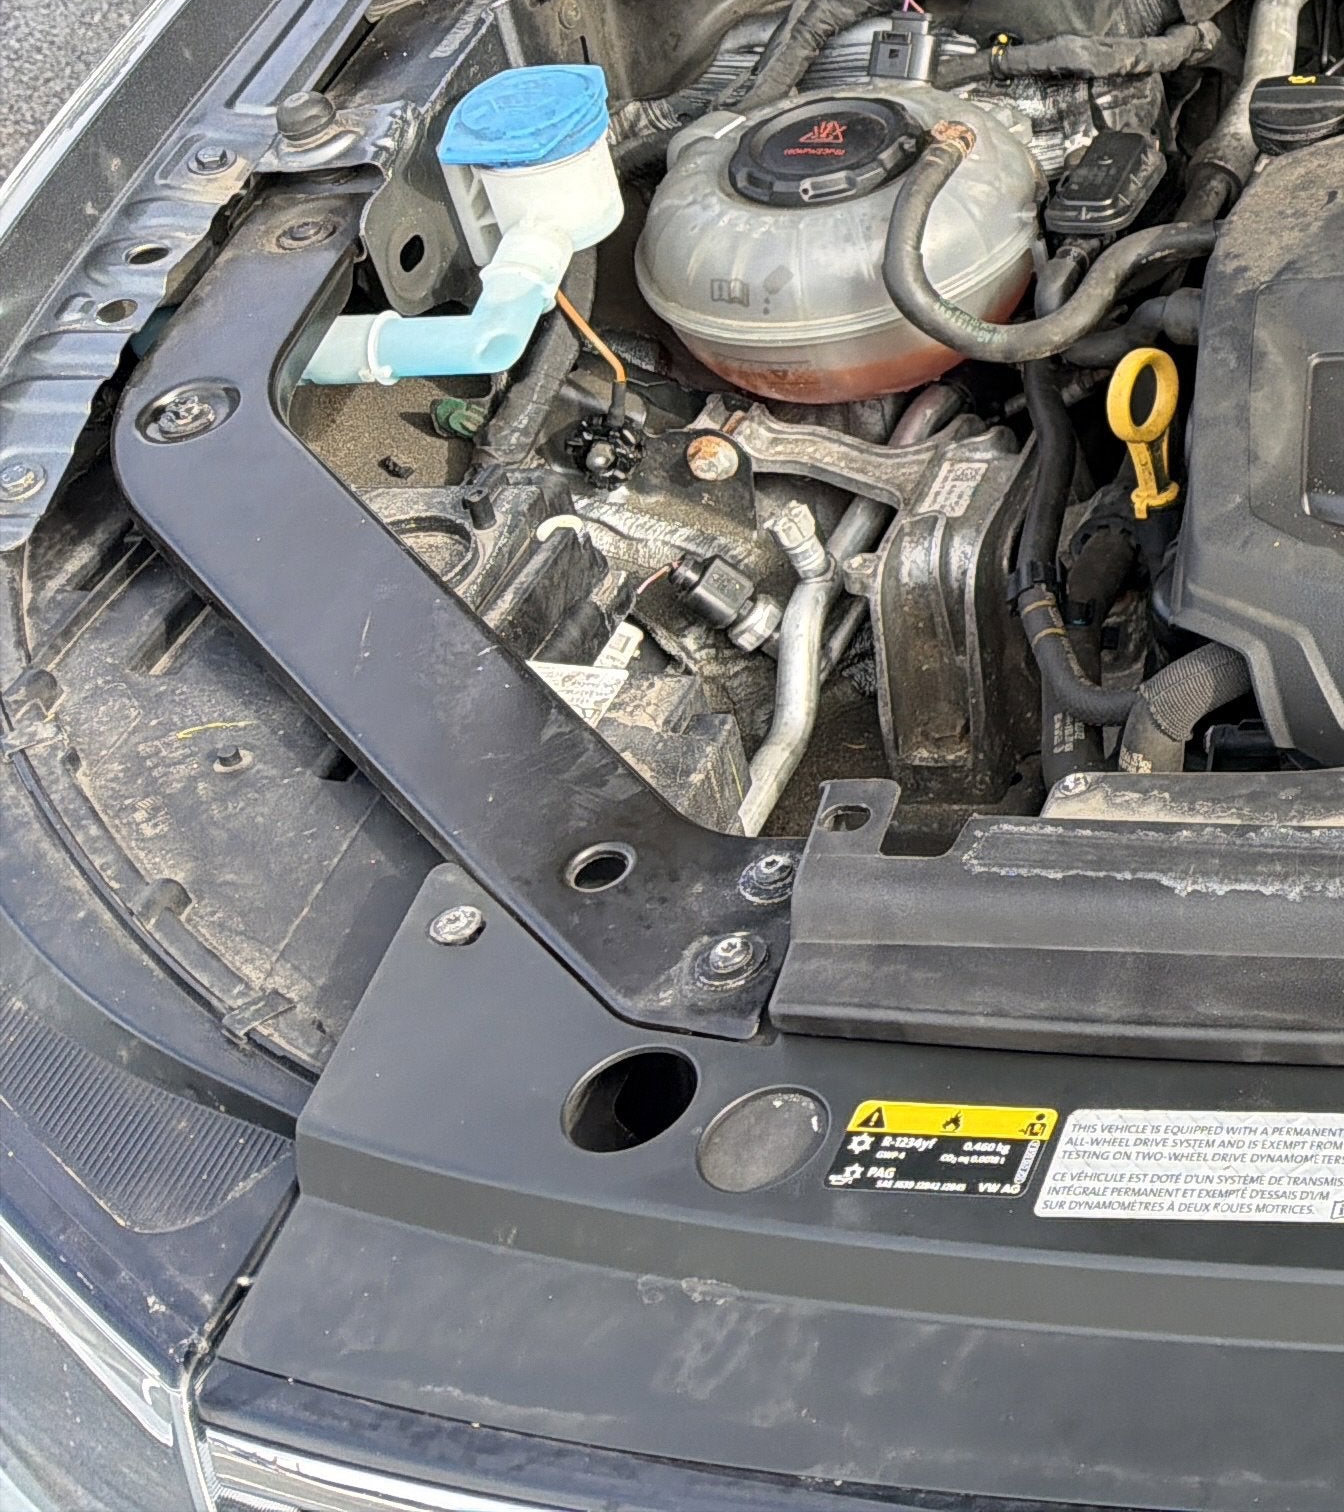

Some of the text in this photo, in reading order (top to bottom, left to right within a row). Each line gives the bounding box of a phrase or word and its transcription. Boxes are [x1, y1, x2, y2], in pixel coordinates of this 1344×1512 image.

[1072, 1124, 1098, 1133] THIS
[1101, 1124, 1148, 1134] VEHICLE
[1150, 1124, 1160, 1134] IS
[1164, 1125, 1223, 1135] EQUIPPED
[1226, 1126, 1258, 1136] WITH
[1260, 1127, 1269, 1136] A
[880, 1136, 938, 1150] R-1234yf
[1065, 1137, 1342, 1150] ALL-WHEEL DRIVE SYSTEM AND IS EXEMPT FROM
[1061, 1150, 1110, 1160] TESTING
[1112, 1150, 1132, 1160] ON
[1135, 1151, 1209, 1162] TWO-WHEEL
[1211, 1152, 1247, 1162] DRIVE
[866, 1166, 897, 1179] PAG
[1052, 1172, 1068, 1182] CE
[1070, 1170, 1126, 1182] VÉHICULE
[1128, 1173, 1148, 1182] EST
[1150, 1172, 1182, 1184] DOTÉ
[1184, 1174, 1214, 1184] D'UN
[1217, 1174, 1266, 1186] SYSTÈME
[1268, 1176, 1284, 1186] DE
[978, 1182, 1020, 1194] VW AG
[1046, 1185, 1298, 1200] INTÉGRALE PERMANENT ET EXEMPTÉ D'ESSAIS
[1042, 1199, 1315, 1215] SUR DYNAMOMÈTRES DEUX ROUES MOTRICES.
